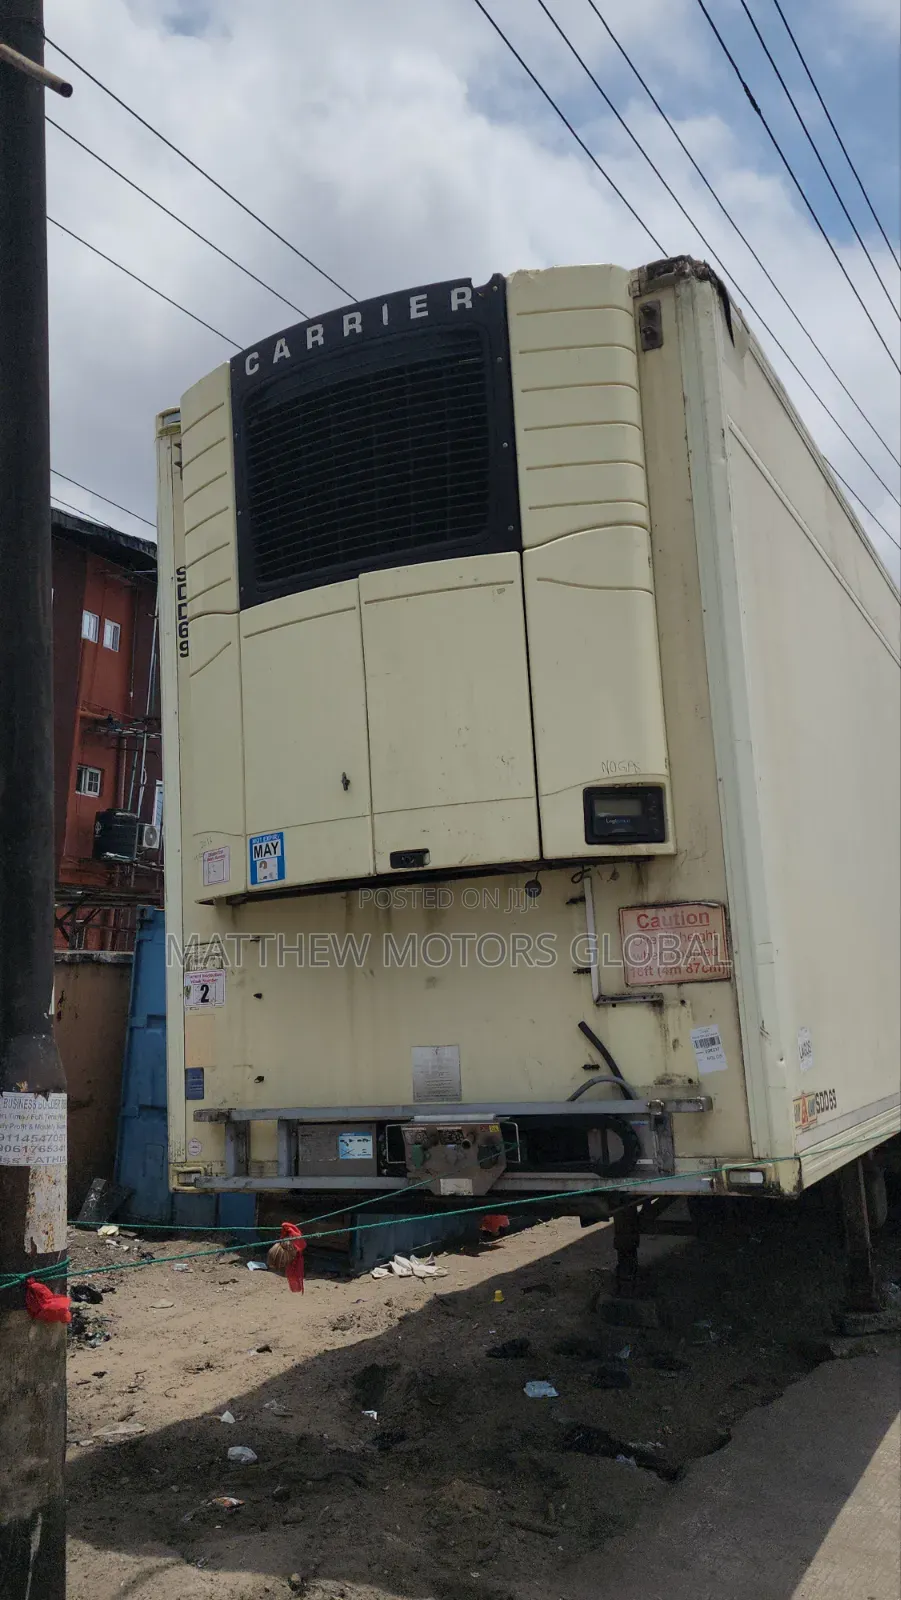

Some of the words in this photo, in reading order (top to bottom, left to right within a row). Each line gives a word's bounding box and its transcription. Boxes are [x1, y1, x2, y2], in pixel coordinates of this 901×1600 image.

[244, 286, 473, 376] CARRIER
[254, 841, 279, 859] MAY
[636, 910, 710, 929] Caution
[200, 984, 210, 1003] 2
[3, 1098, 37, 1109] BUSINESS
